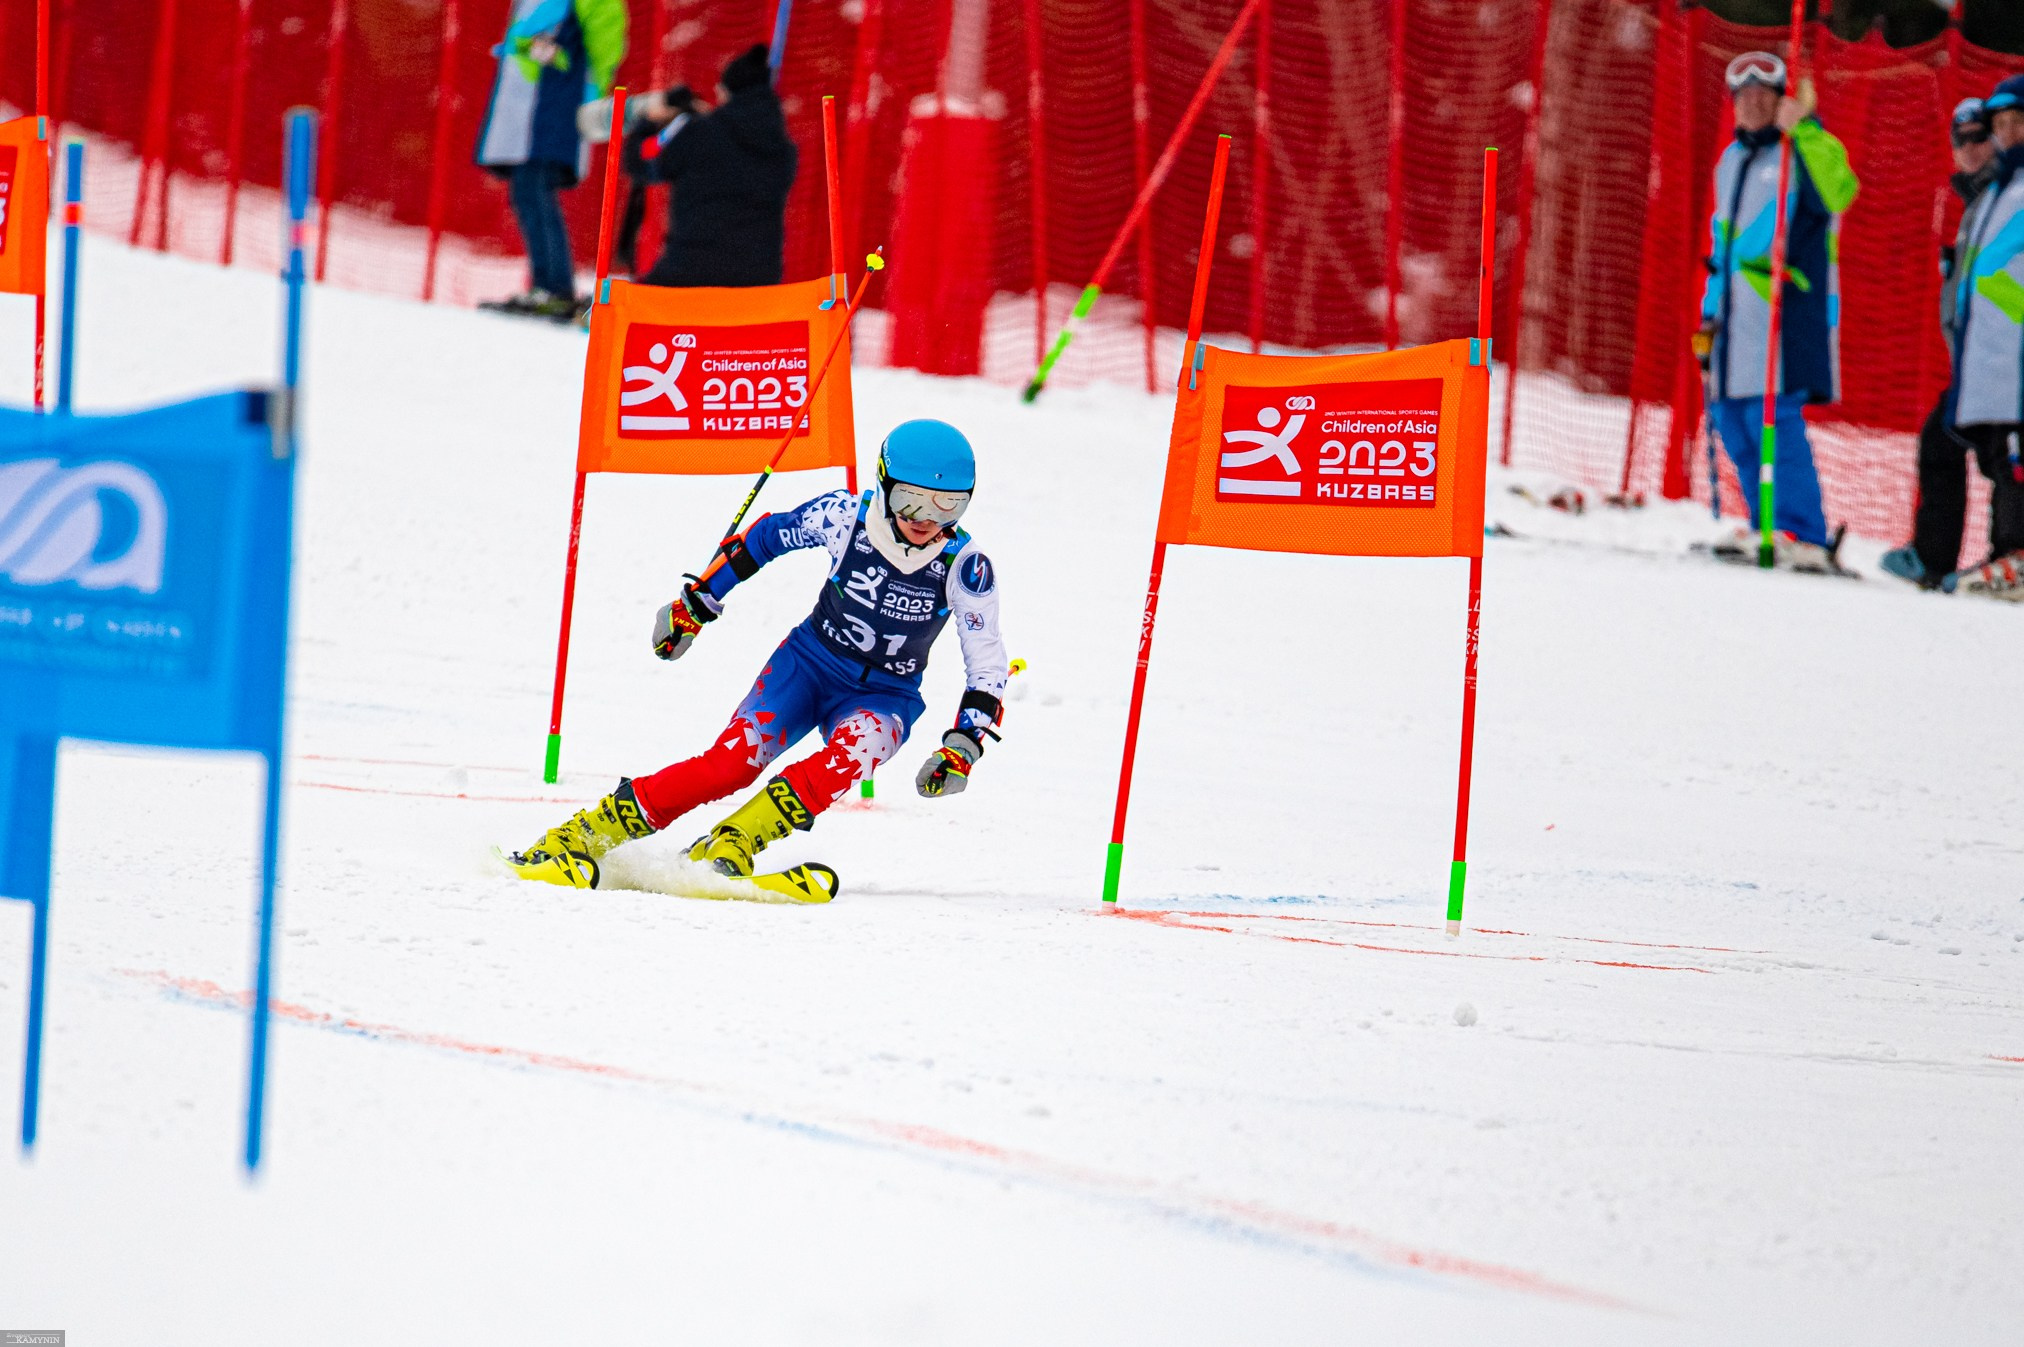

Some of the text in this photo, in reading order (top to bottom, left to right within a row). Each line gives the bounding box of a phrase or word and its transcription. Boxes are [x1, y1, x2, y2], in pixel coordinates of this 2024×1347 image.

[701, 357, 807, 372] Children of Asia
[702, 375, 809, 411] 2023
[1321, 420, 1437, 434] Children of Asia
[1318, 440, 1436, 477] 2023
[1316, 482, 1435, 501] KUZBASS
[887, 583, 915, 596] Children
[921, 591, 936, 599] Asia
[882, 592, 935, 614] 2023
[673, 616, 695, 629] LEKI
[879, 607, 932, 622] KUZBASS
[841, 613, 908, 656] 31
